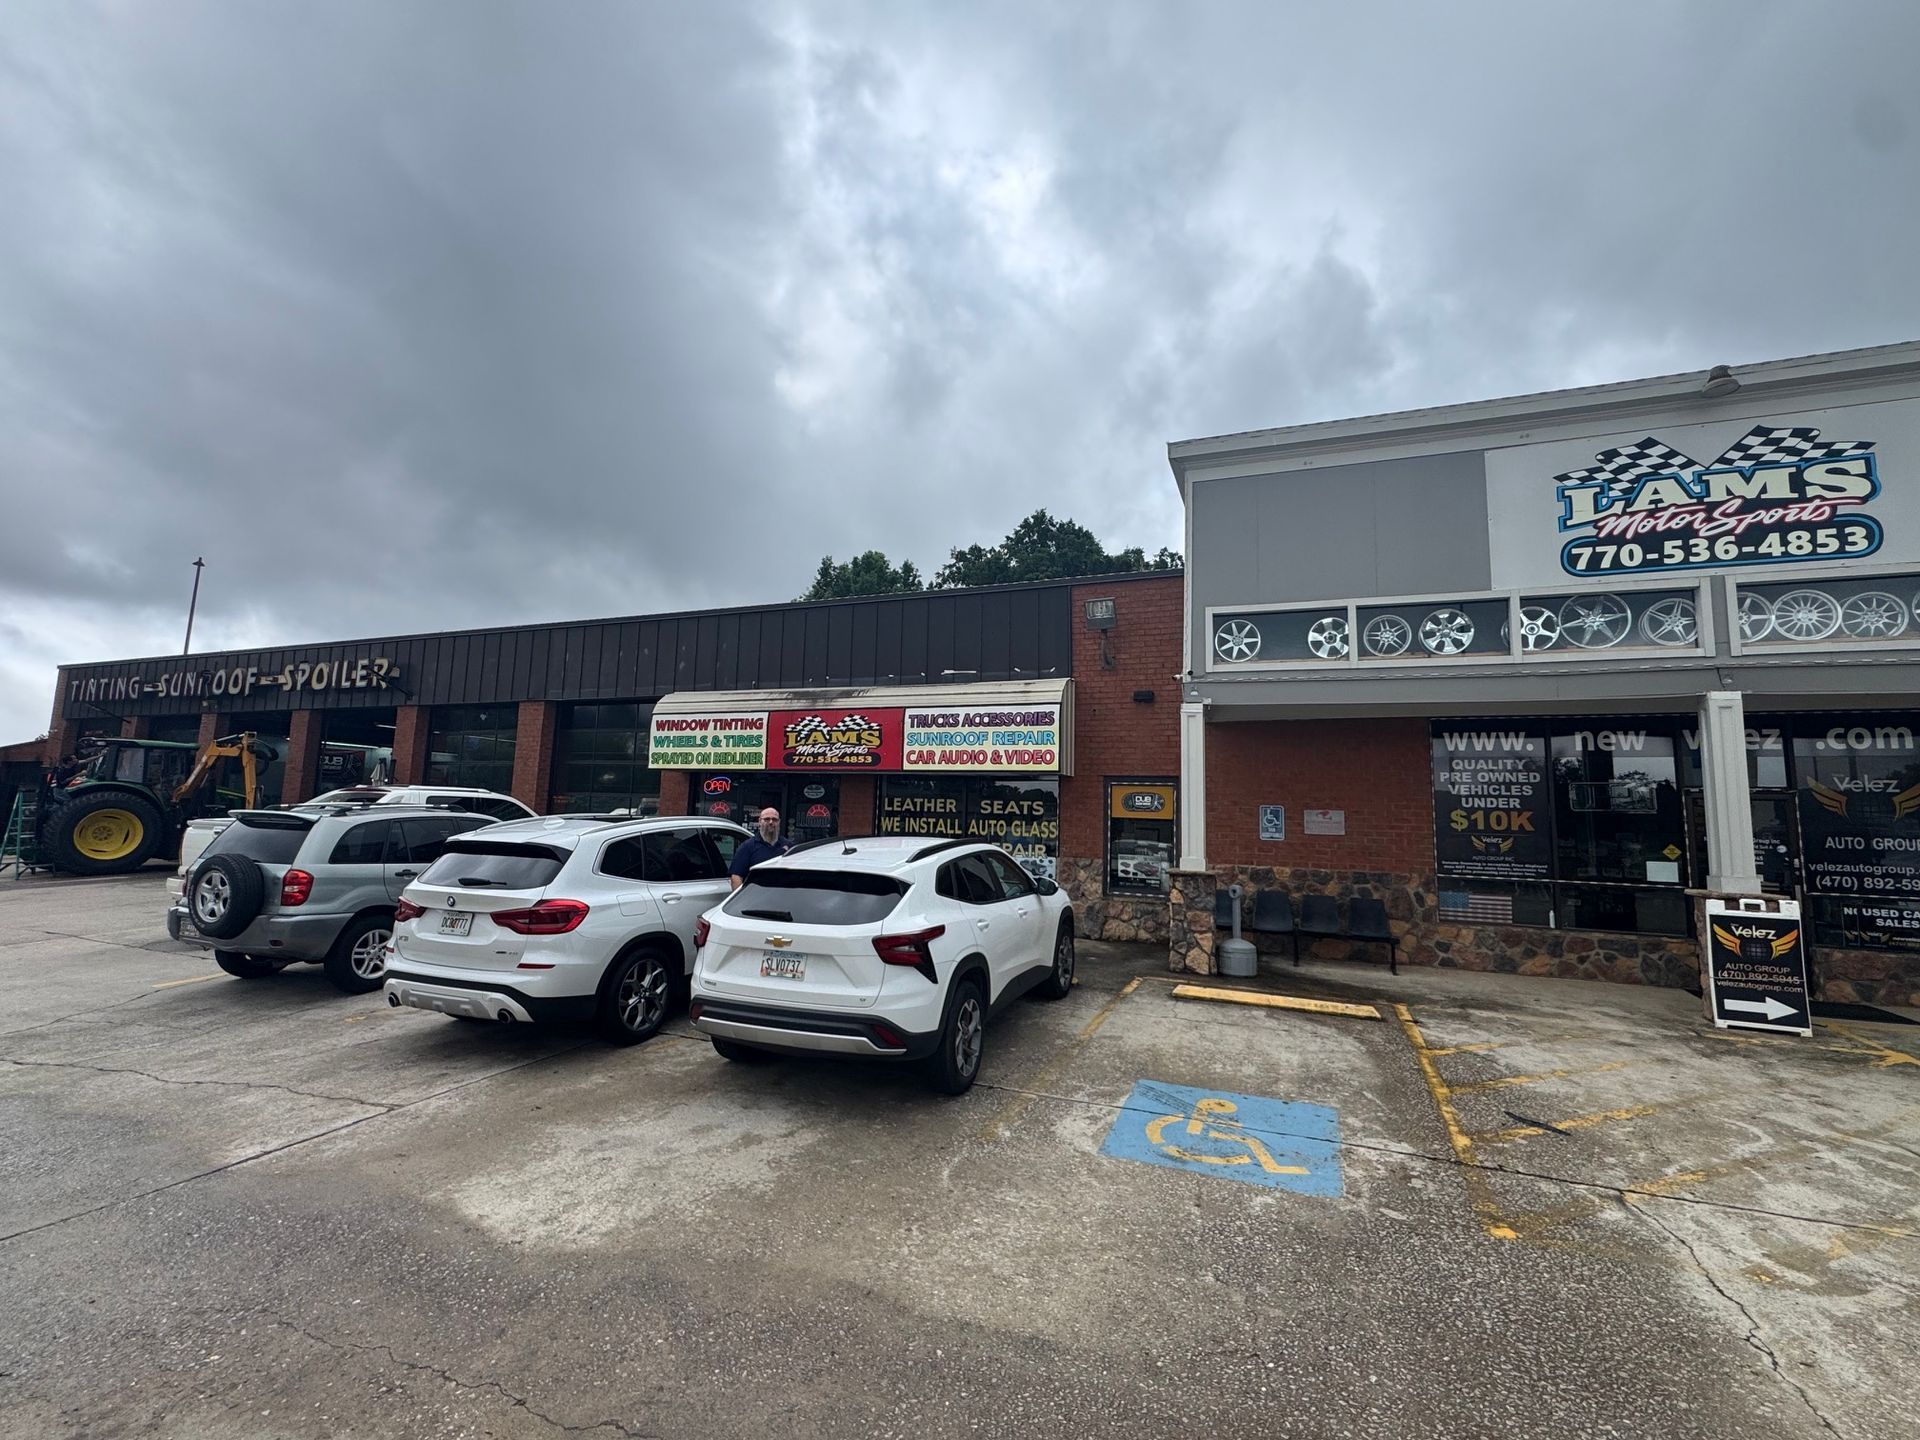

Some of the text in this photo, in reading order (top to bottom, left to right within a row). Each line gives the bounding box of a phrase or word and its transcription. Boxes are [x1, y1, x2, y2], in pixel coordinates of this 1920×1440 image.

[1563, 458, 1874, 527] LAMS
[1571, 526, 1869, 570] 770-536-4853
[71, 676, 141, 702] TINTING
[656, 717, 764, 732] WINDOW TINTING
[909, 711, 1055, 728] TRUCKS ACCESSORIES
[653, 734, 763, 748] WHEELS & TIRES
[907, 730, 1056, 747] SUNROOF REPAIR
[1575, 730, 1647, 751] new
[1816, 726, 1914, 750] .com
[651, 751, 763, 765] SPRAYED ON BEDLINER
[792, 755, 873, 764] 770-536-4853
[906, 749, 1055, 765] CAR AUDIO & VIDEO
[1451, 759, 1526, 770] QUALITY
[1440, 771, 1541, 783] PRE OWNED
[1832, 774, 1901, 793] Velez
[704, 780, 731, 791] OPEN
[1448, 784, 1534, 796] VEHICLES
[884, 797, 1045, 816] LEATHER SEATS
[1461, 797, 1521, 809] UNDER
[881, 816, 1057, 839] WE INSTALL AUTO GLASS
[1450, 808, 1535, 832] $10K
[1825, 836, 1920, 851] AUTO GROU
[1808, 862, 1920, 876] velezautogroup.
[1816, 875, 1858, 891] (470)
[1861, 907, 1899, 918] USED
[1875, 918, 1920, 929] SALES
[1730, 924, 1777, 940] Velez
[1725, 962, 1791, 974] AUTO GROUP
[1718, 969, 1800, 985] (470) 892-5945
[1716, 980, 1803, 994] velezautogroup.com
